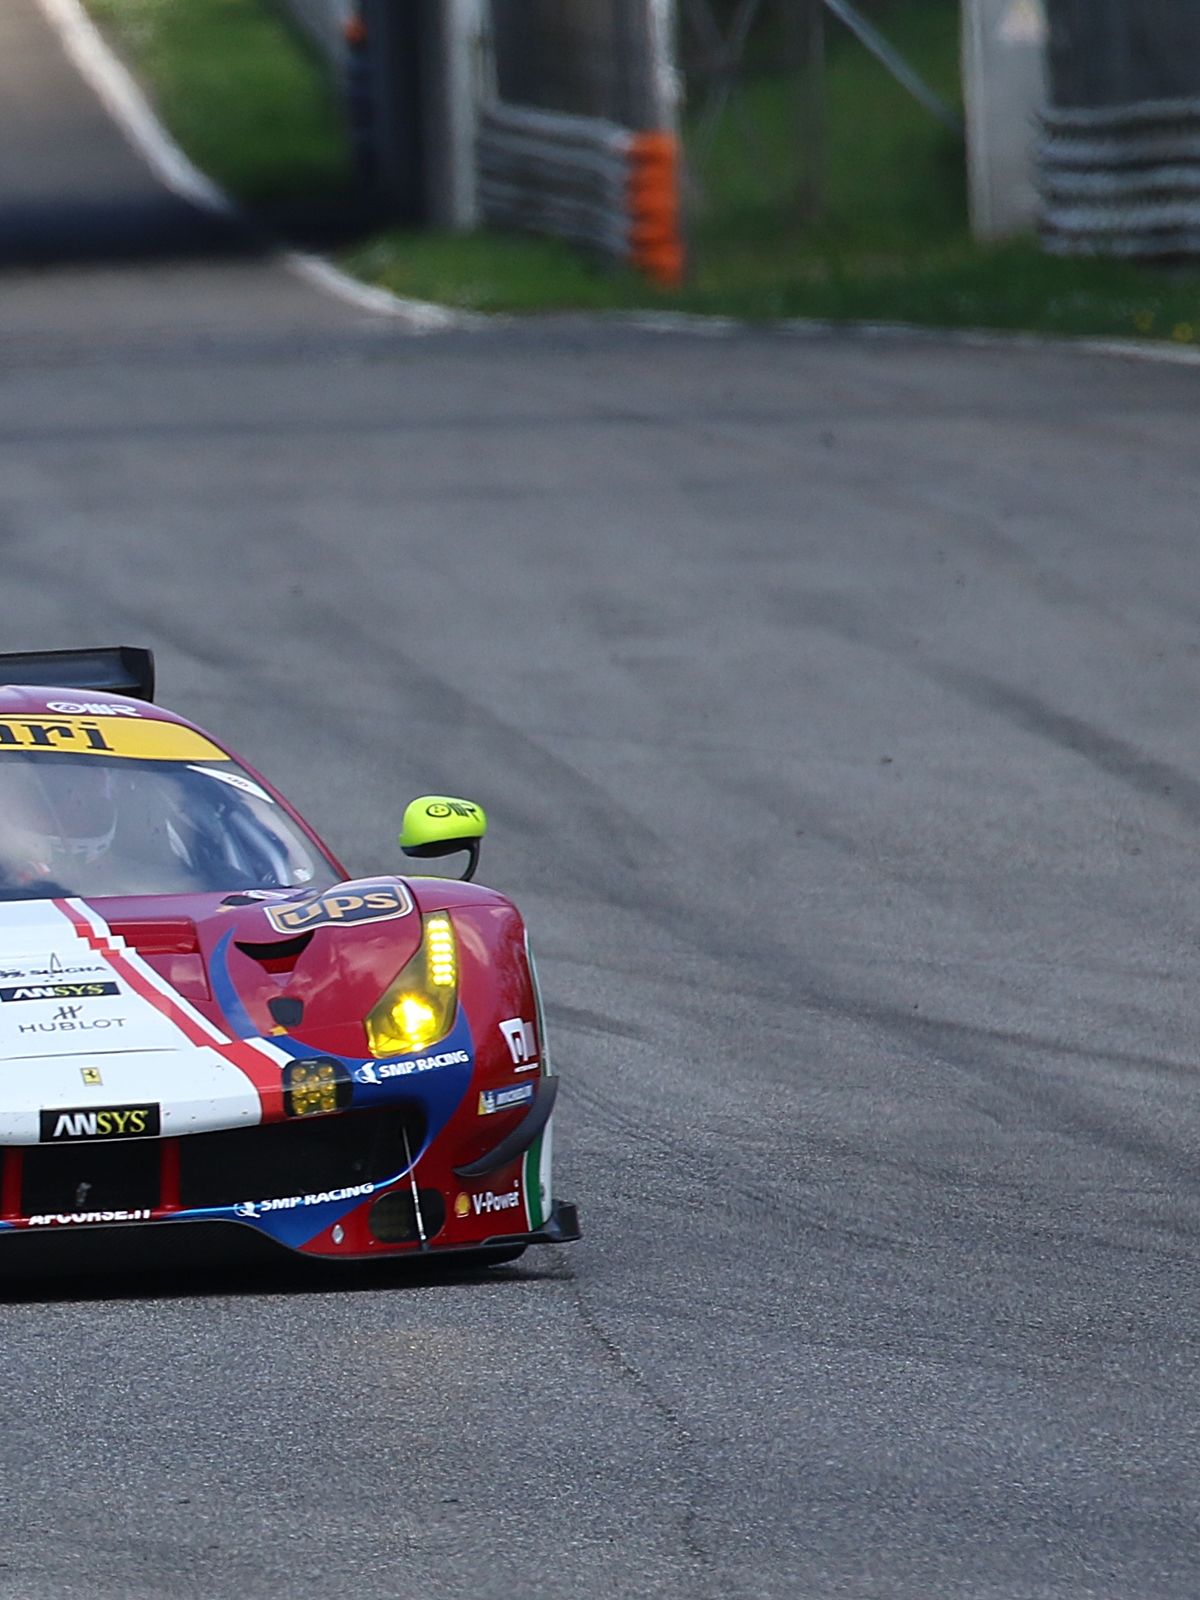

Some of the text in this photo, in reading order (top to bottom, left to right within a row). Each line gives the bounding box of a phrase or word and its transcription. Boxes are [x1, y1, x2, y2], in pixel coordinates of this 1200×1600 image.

[12, 984, 105, 999] ANSYS
[18, 1017, 127, 1034] HUBLOT
[378, 1050, 470, 1078] SMP RACING
[52, 1110, 149, 1137] ANSYS
[303, 1182, 375, 1206] RACING
[472, 1191, 519, 1215] V-Power
